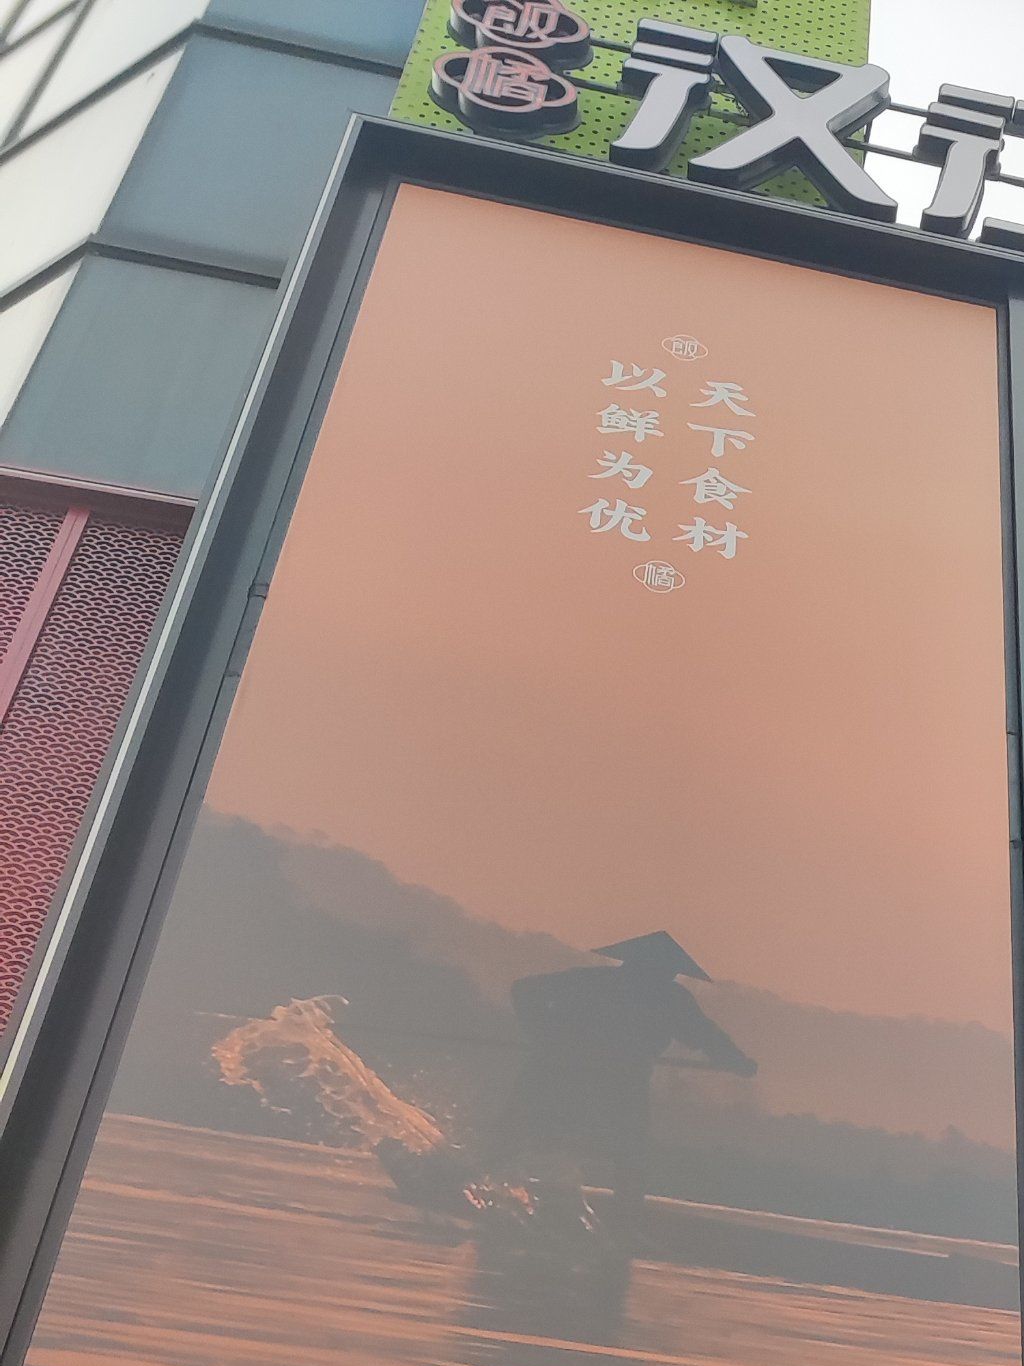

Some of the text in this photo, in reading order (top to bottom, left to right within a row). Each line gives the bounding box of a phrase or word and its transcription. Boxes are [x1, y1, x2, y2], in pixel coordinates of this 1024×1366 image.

[577, 359, 668, 542] 以鲜为优
[672, 381, 757, 559] 天下食材
